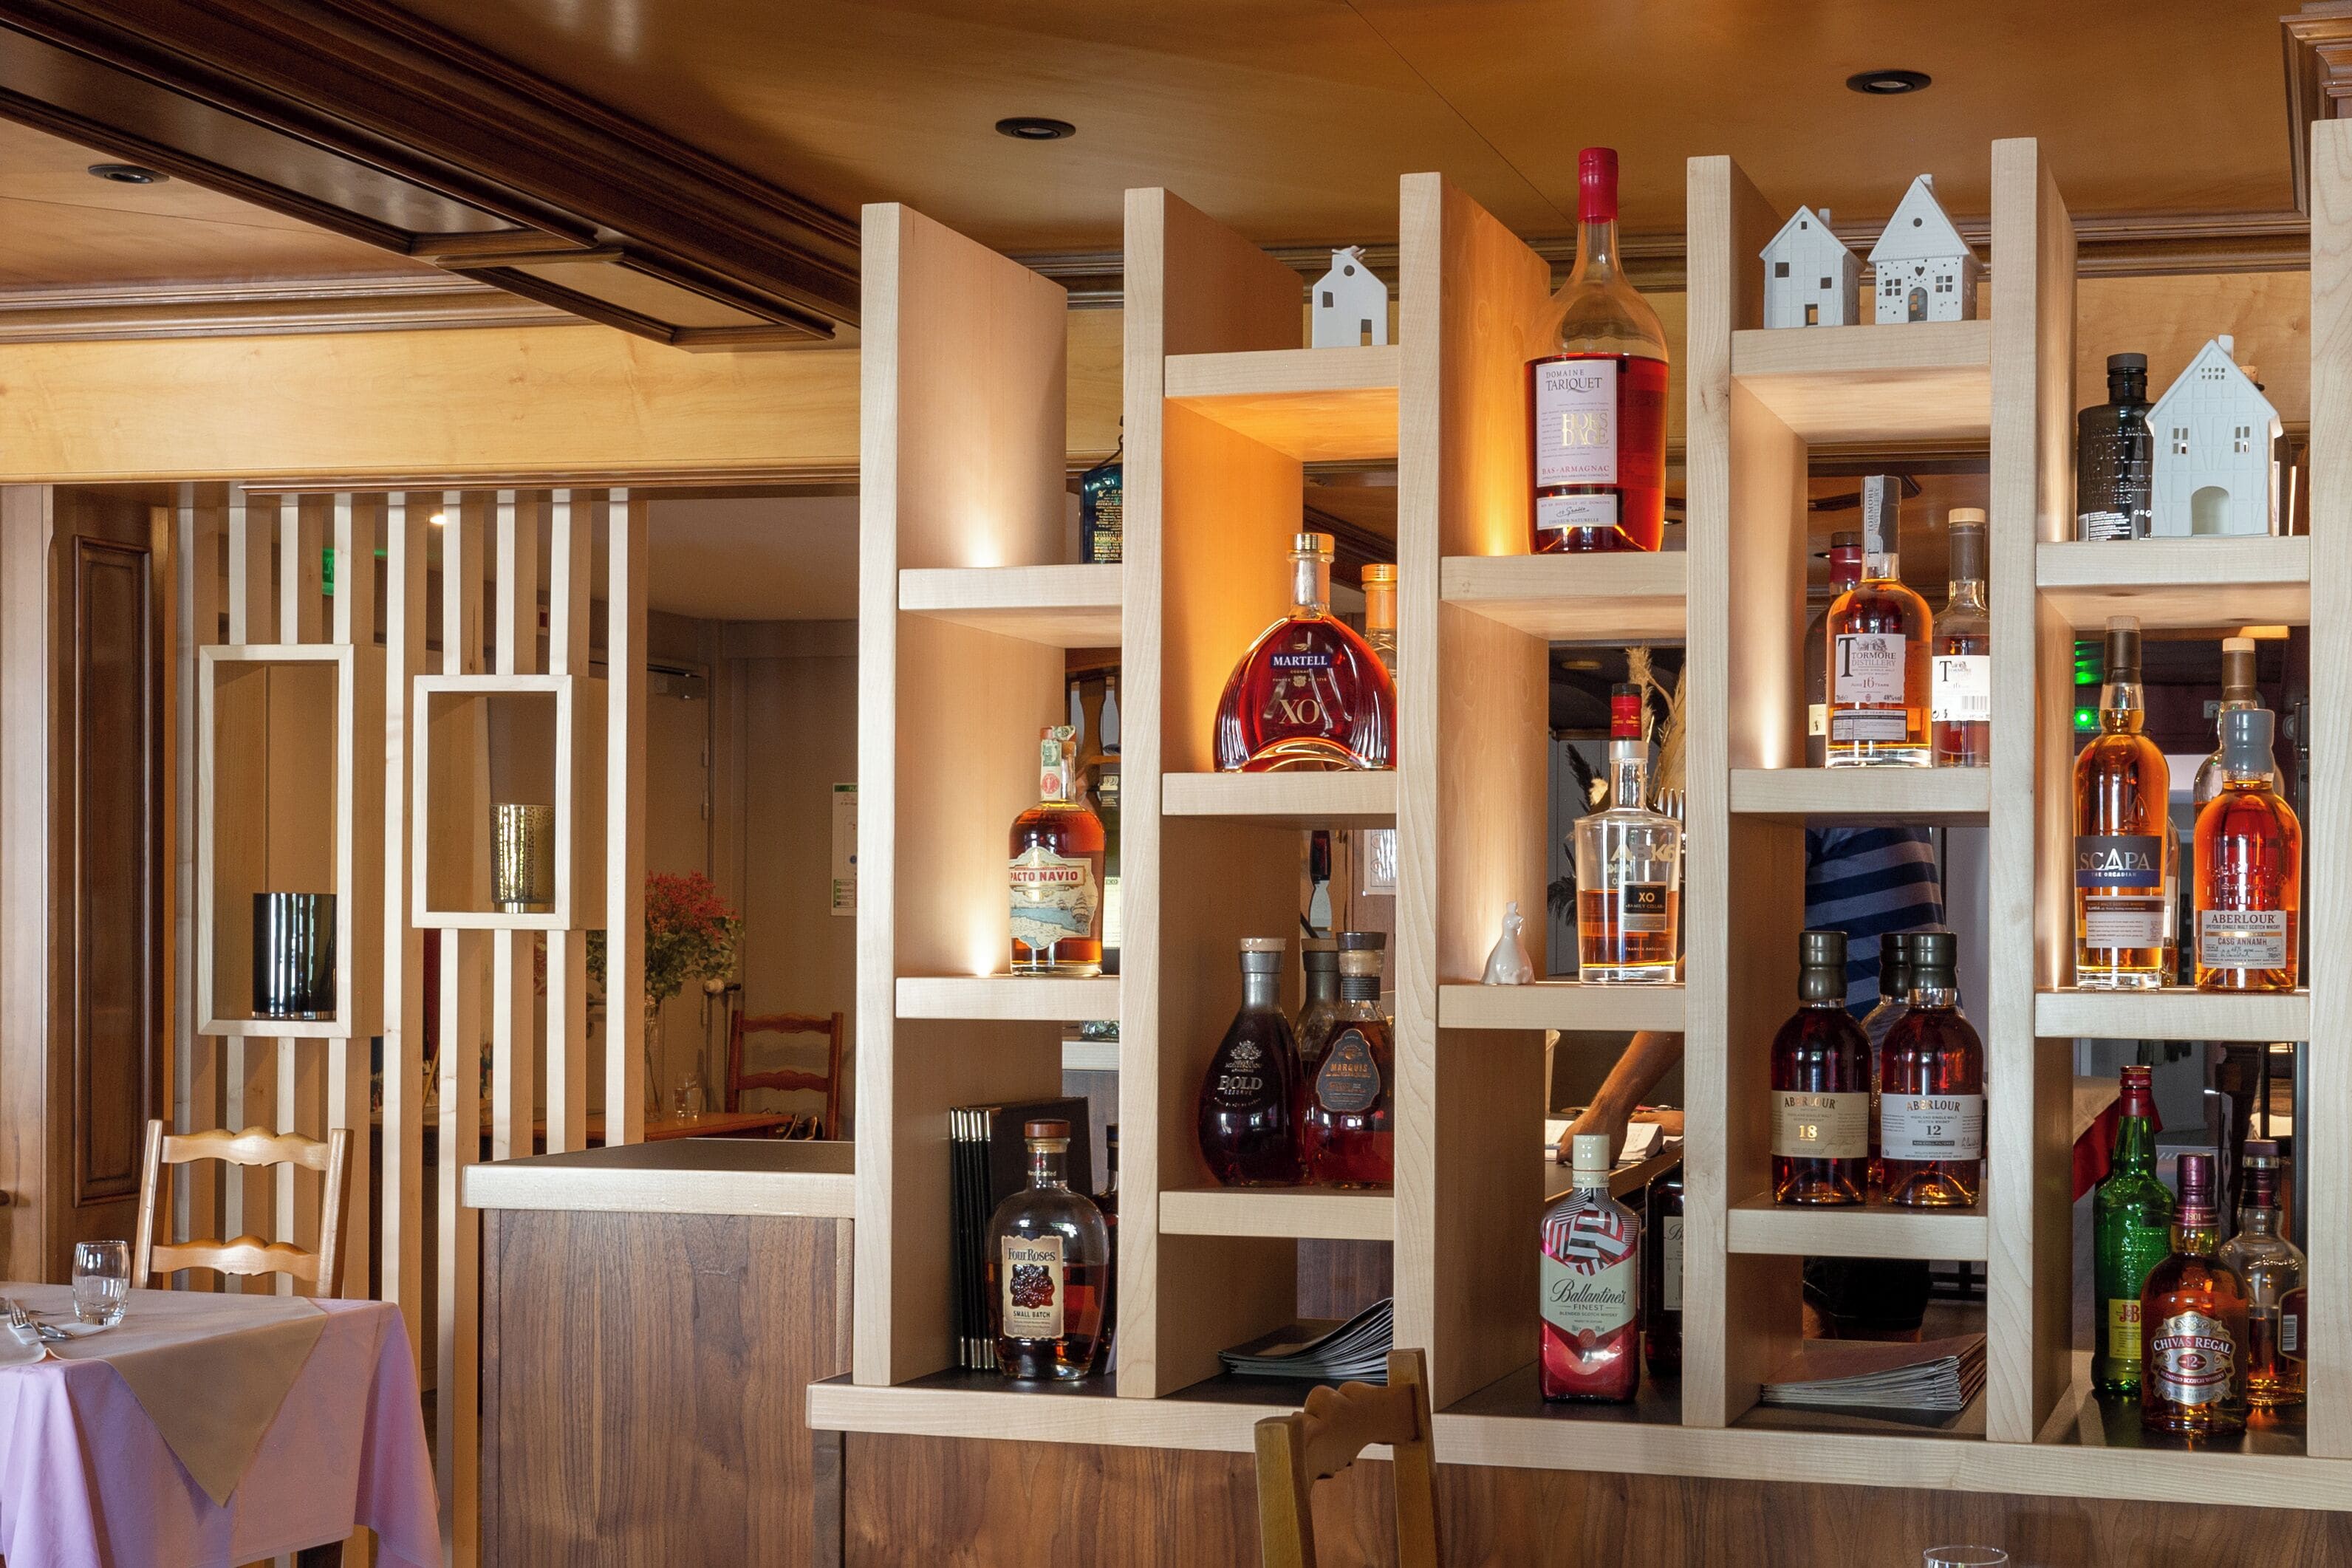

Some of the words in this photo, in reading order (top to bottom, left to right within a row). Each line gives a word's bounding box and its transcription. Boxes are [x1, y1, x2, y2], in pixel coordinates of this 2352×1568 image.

[1546, 369, 1584, 379] DOMAINE
[1545, 377, 1602, 393] TARIQUET
[1273, 656, 1327, 666] MARTELL
[1851, 659, 1896, 667] DISTILLERY
[1863, 677, 1875, 688] 16
[1279, 699, 1320, 725] XO
[1610, 843, 1675, 862] ABK6
[2080, 848, 2150, 871] SCAPA
[1039, 871, 1078, 881] NAVIO
[1638, 892, 1655, 903] XO
[2212, 914, 2275, 924] ABERLOUR
[2218, 937, 2235, 945] CASG
[2237, 937, 2267, 945] ANNAMH
[1330, 1064, 1368, 1072] MARQUIS
[1217, 1075, 1264, 1090] BOLD
[1784, 1095, 1836, 1109] ABERLOUR
[1907, 1099, 1960, 1112] ABERLOUR
[1799, 1125, 1817, 1138] 18
[1927, 1125, 1941, 1136] 12
[2185, 1212, 2201, 1221] 1801
[1008, 1247, 1027, 1261] Four
[1028, 1248, 1056, 1261] Roses
[1550, 1278, 1627, 1305] Ballantine's
[2153, 1337, 2192, 1351] CHIVAS
[2195, 1337, 2231, 1354] REGAL
[2187, 1356, 2198, 1367] 12
